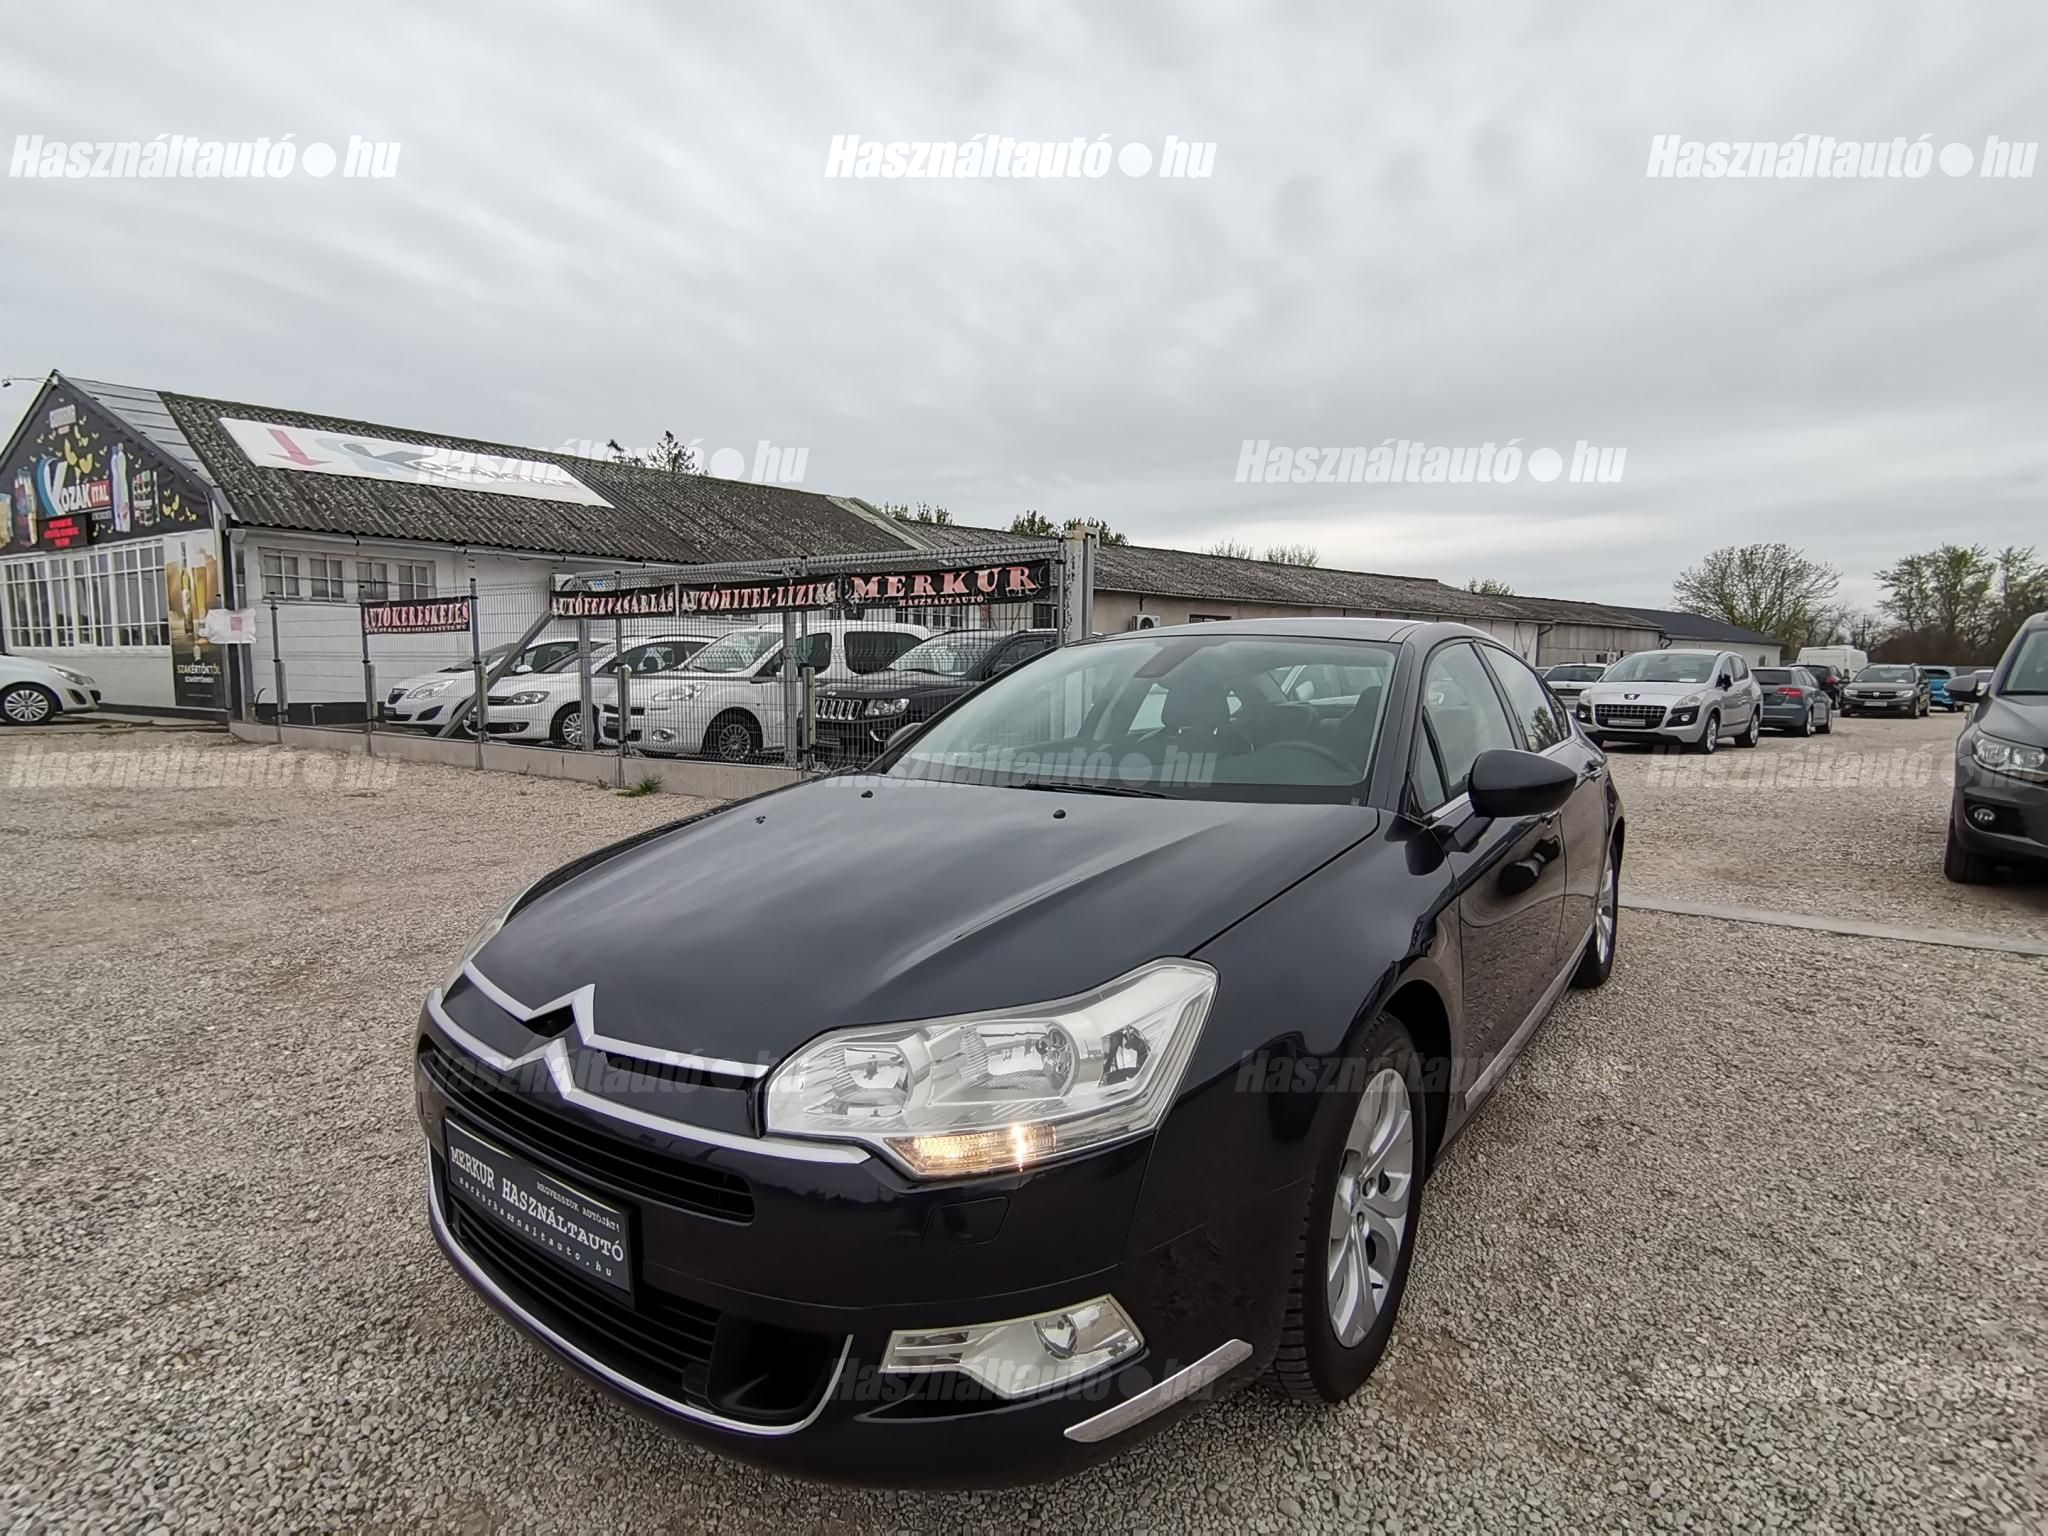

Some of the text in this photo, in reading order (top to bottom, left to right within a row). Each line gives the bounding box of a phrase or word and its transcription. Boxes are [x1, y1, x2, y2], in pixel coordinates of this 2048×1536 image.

[91, 484, 110, 503] ITAL
[851, 566, 1037, 598] MERKUR
[450, 1146, 624, 1262] MERKUR HASZNÁLTAUTÓ
